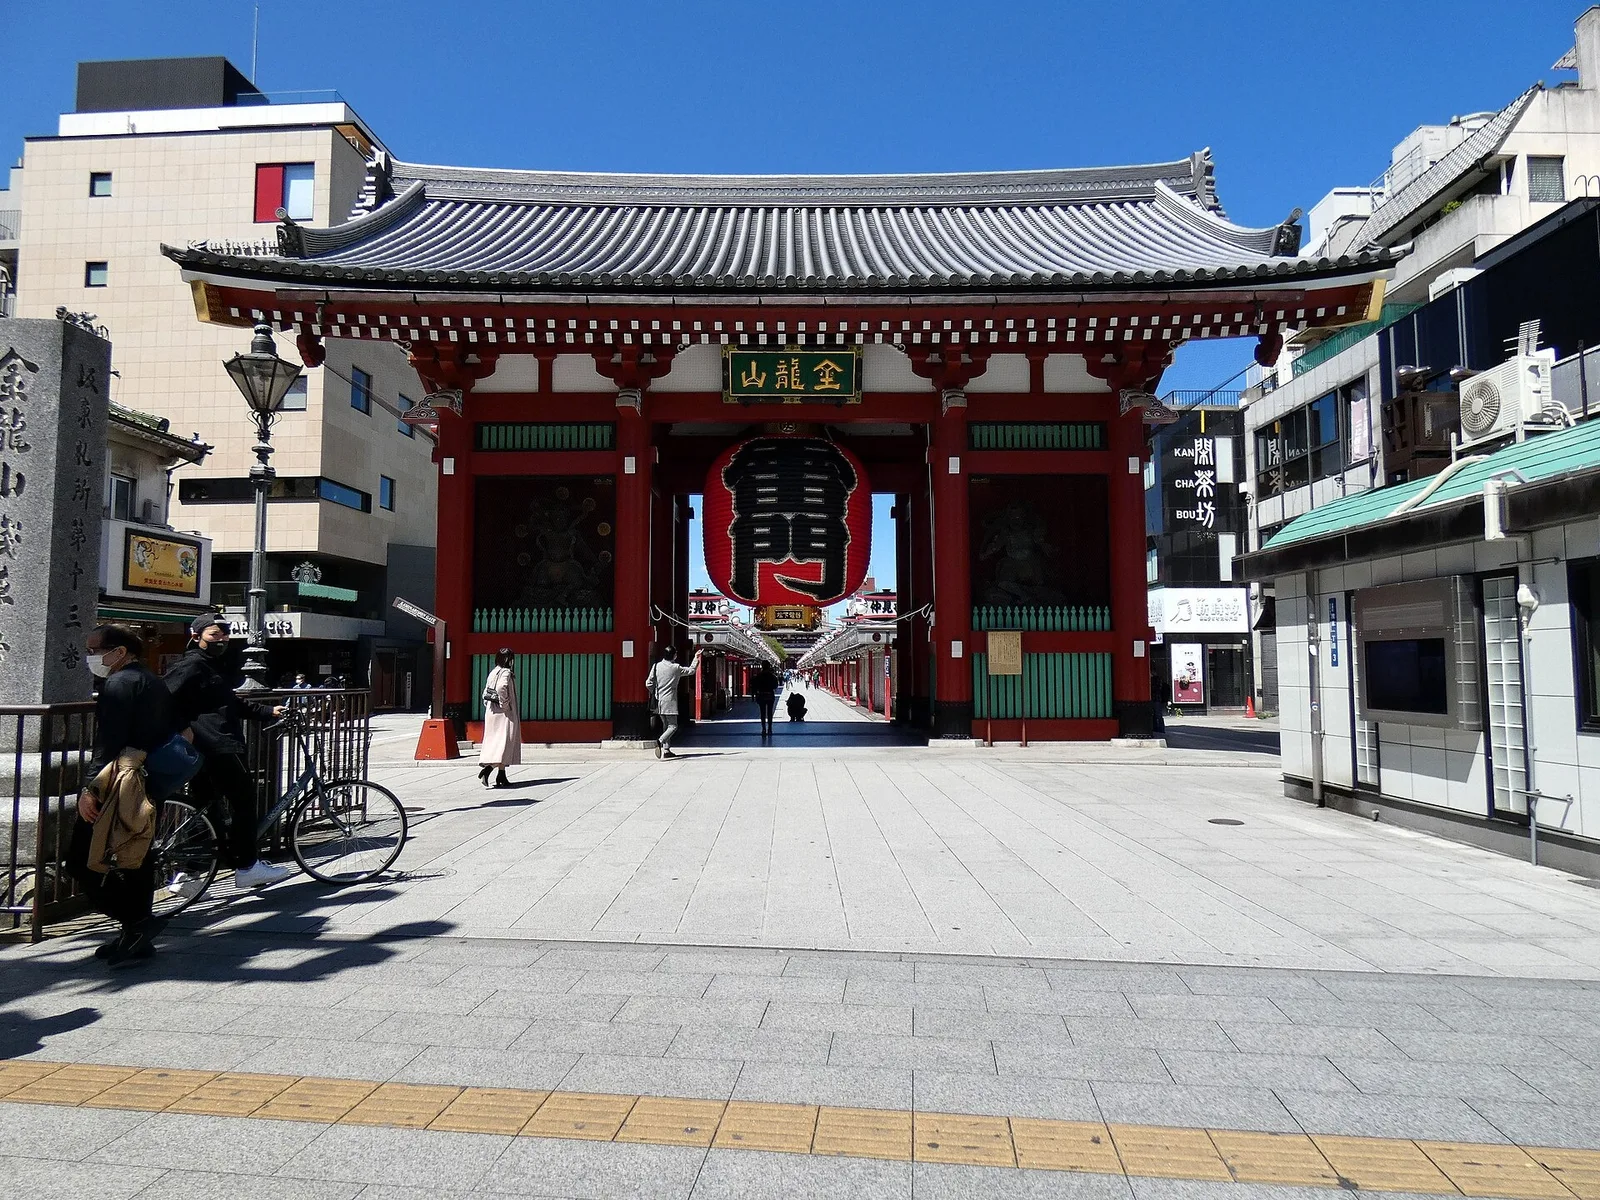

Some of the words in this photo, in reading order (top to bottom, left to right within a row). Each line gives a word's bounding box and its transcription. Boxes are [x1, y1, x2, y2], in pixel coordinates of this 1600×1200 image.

[741, 357, 843, 390] 金龍山
[1174, 448, 1194, 457] KAN
[1175, 479, 1195, 488] CHA
[721, 437, 858, 601] 雷門
[1176, 510, 1195, 519] BOU
[227, 620, 292, 631] ARCKS
